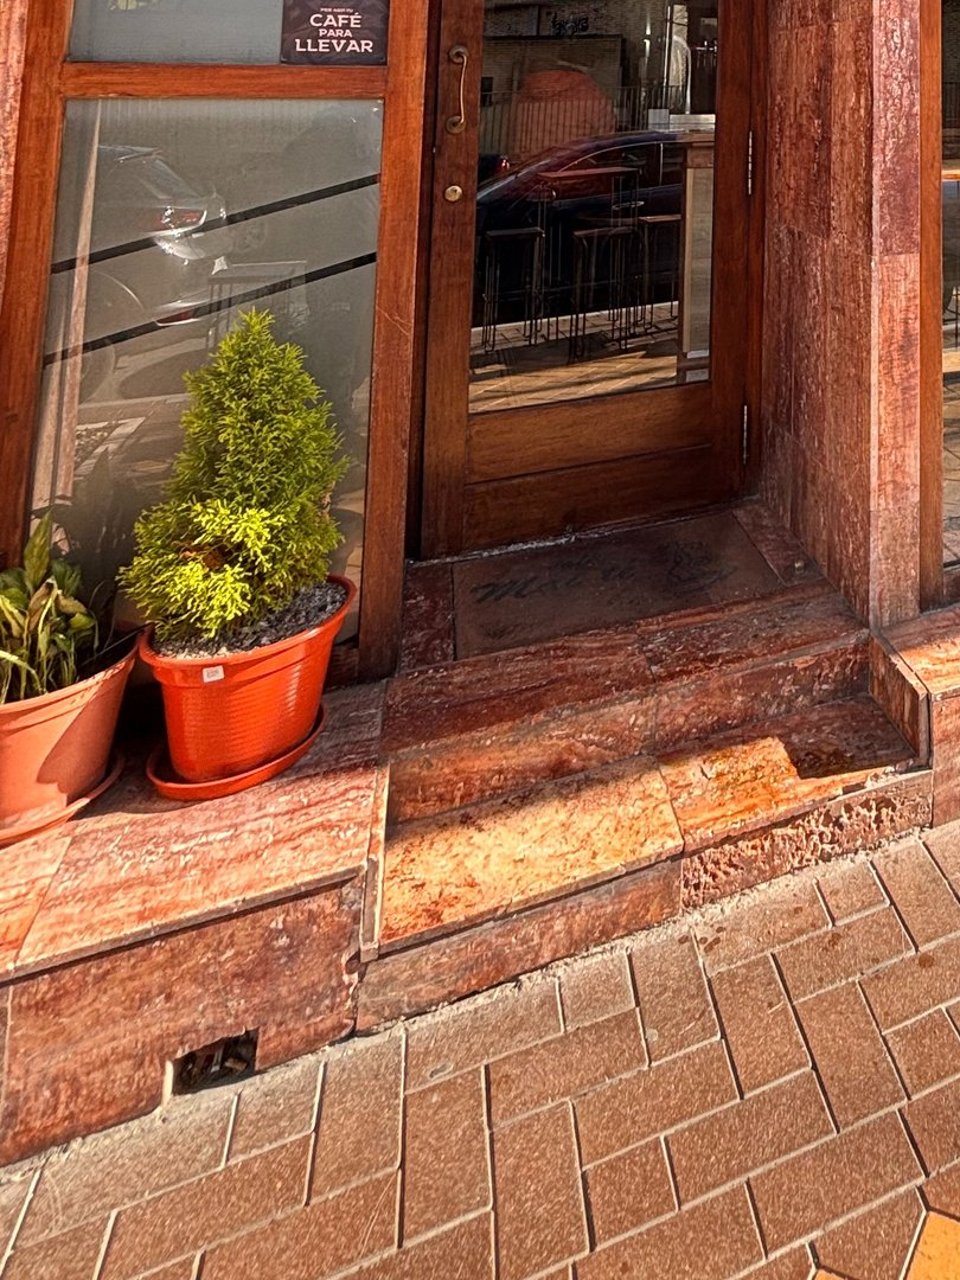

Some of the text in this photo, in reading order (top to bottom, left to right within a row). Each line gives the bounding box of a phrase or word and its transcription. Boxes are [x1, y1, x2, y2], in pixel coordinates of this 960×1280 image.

[310, 12, 362, 28] CAFÉ
[318, 28, 353, 38] PARA
[295, 38, 373, 53] LLEVAR
